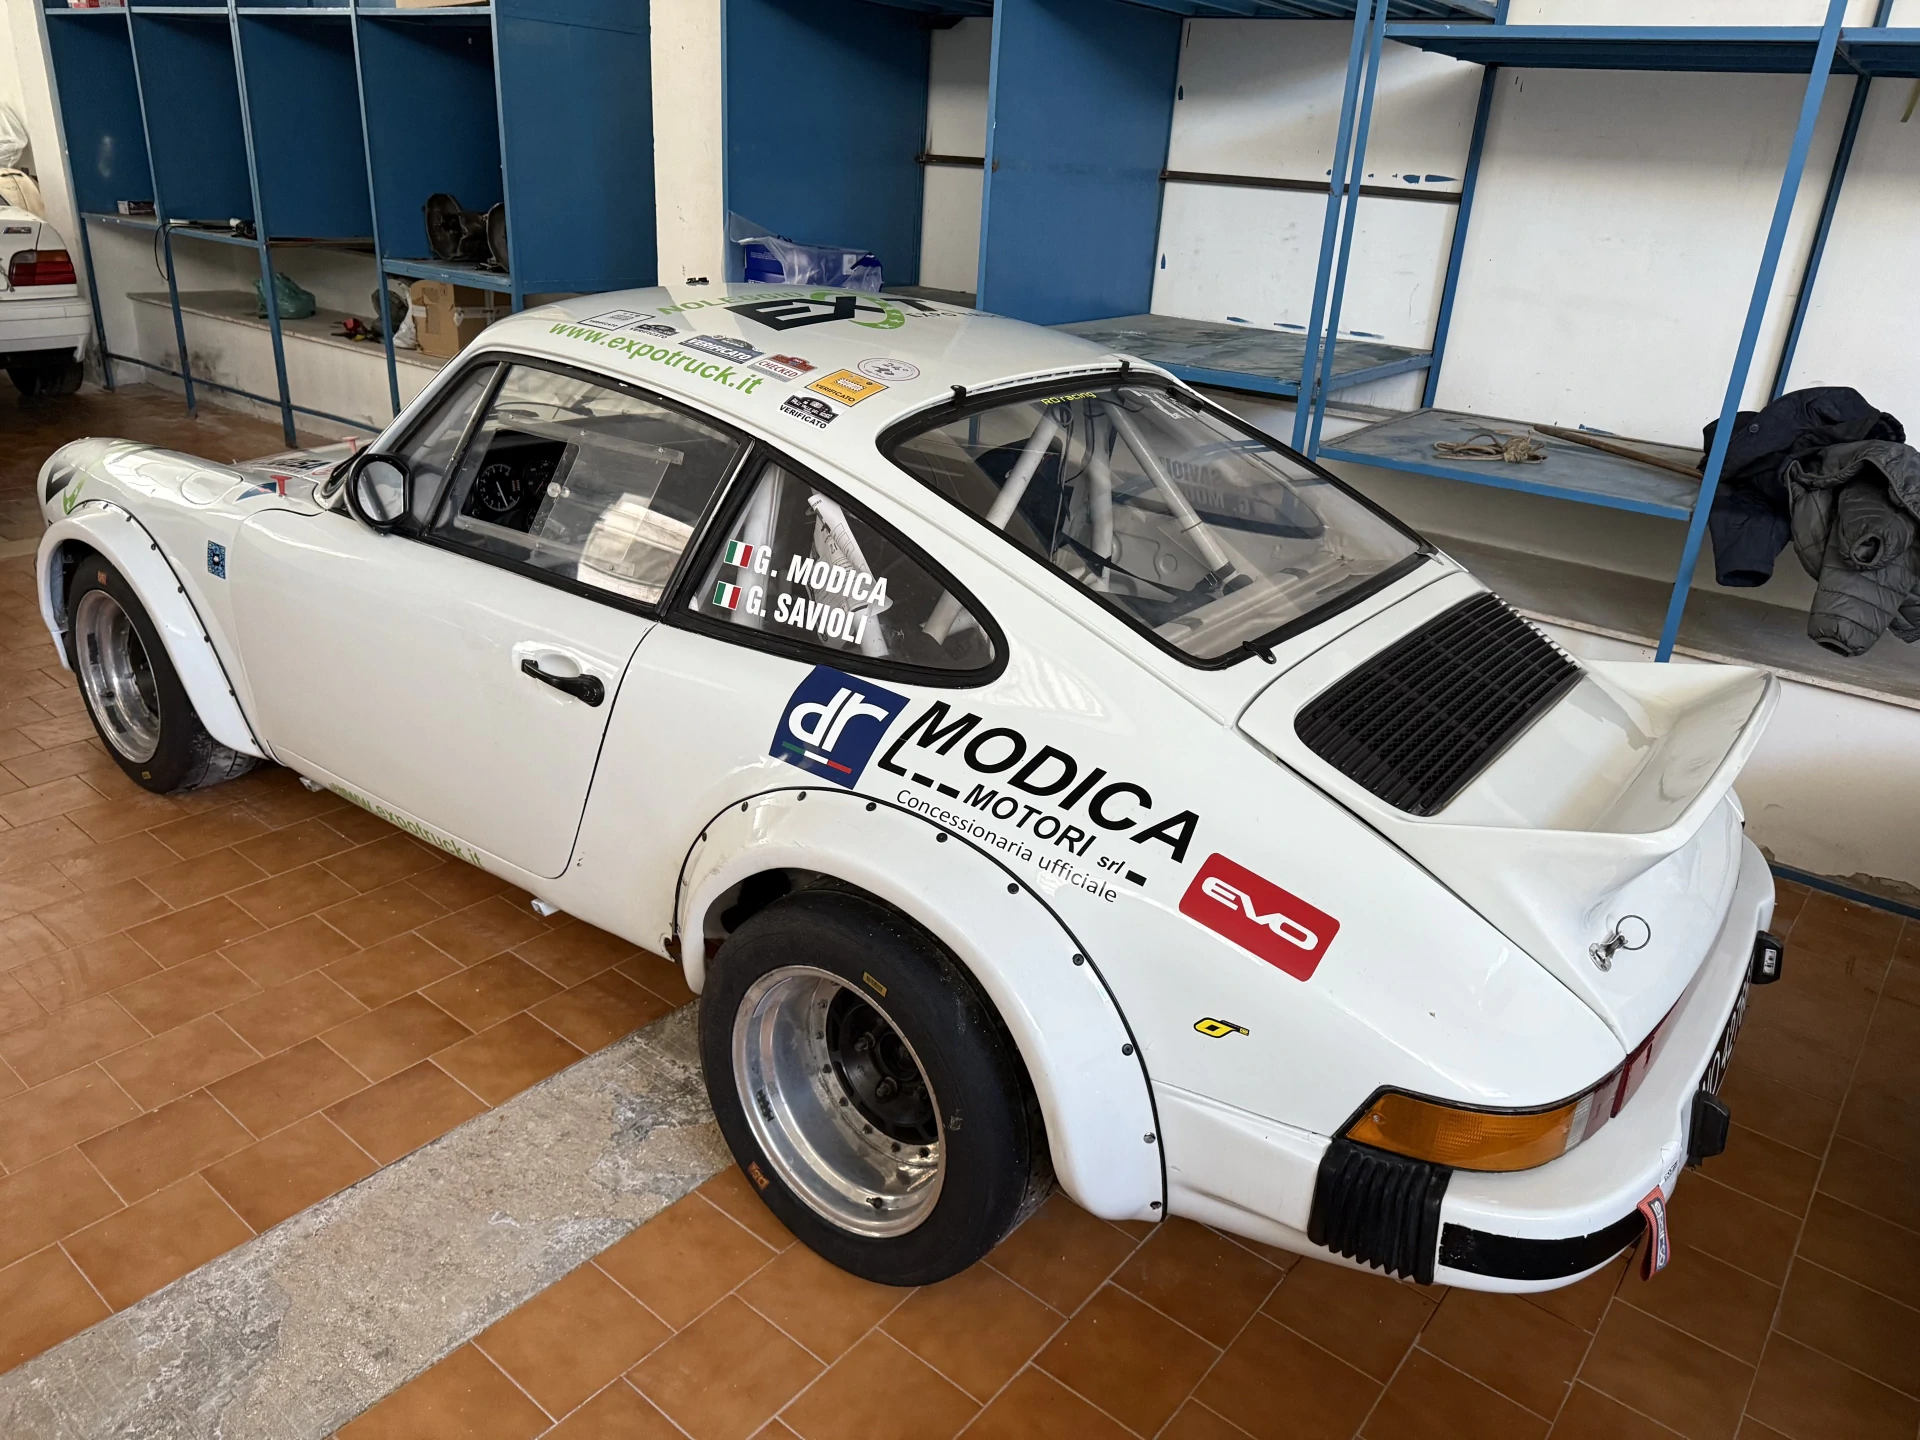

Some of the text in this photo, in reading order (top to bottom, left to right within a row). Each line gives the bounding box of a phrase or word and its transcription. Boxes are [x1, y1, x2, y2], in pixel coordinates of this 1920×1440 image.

[549, 321, 765, 395] www.expotruck.it
[688, 338, 752, 361] VERIFICATO
[758, 360, 800, 379] CHECKED
[779, 404, 827, 429] VERIFICATO
[815, 383, 856, 403] VERIFICATO
[753, 545, 888, 607] G. MODICA
[745, 585, 868, 645] G. SAVIOLI
[788, 687, 889, 747] dr
[916, 700, 1200, 864] MODICA
[896, 788, 1118, 903] Concessionaria ufficiale
[964, 783, 1127, 875] MOTORI srl
[1200, 875, 1319, 951] EVO
